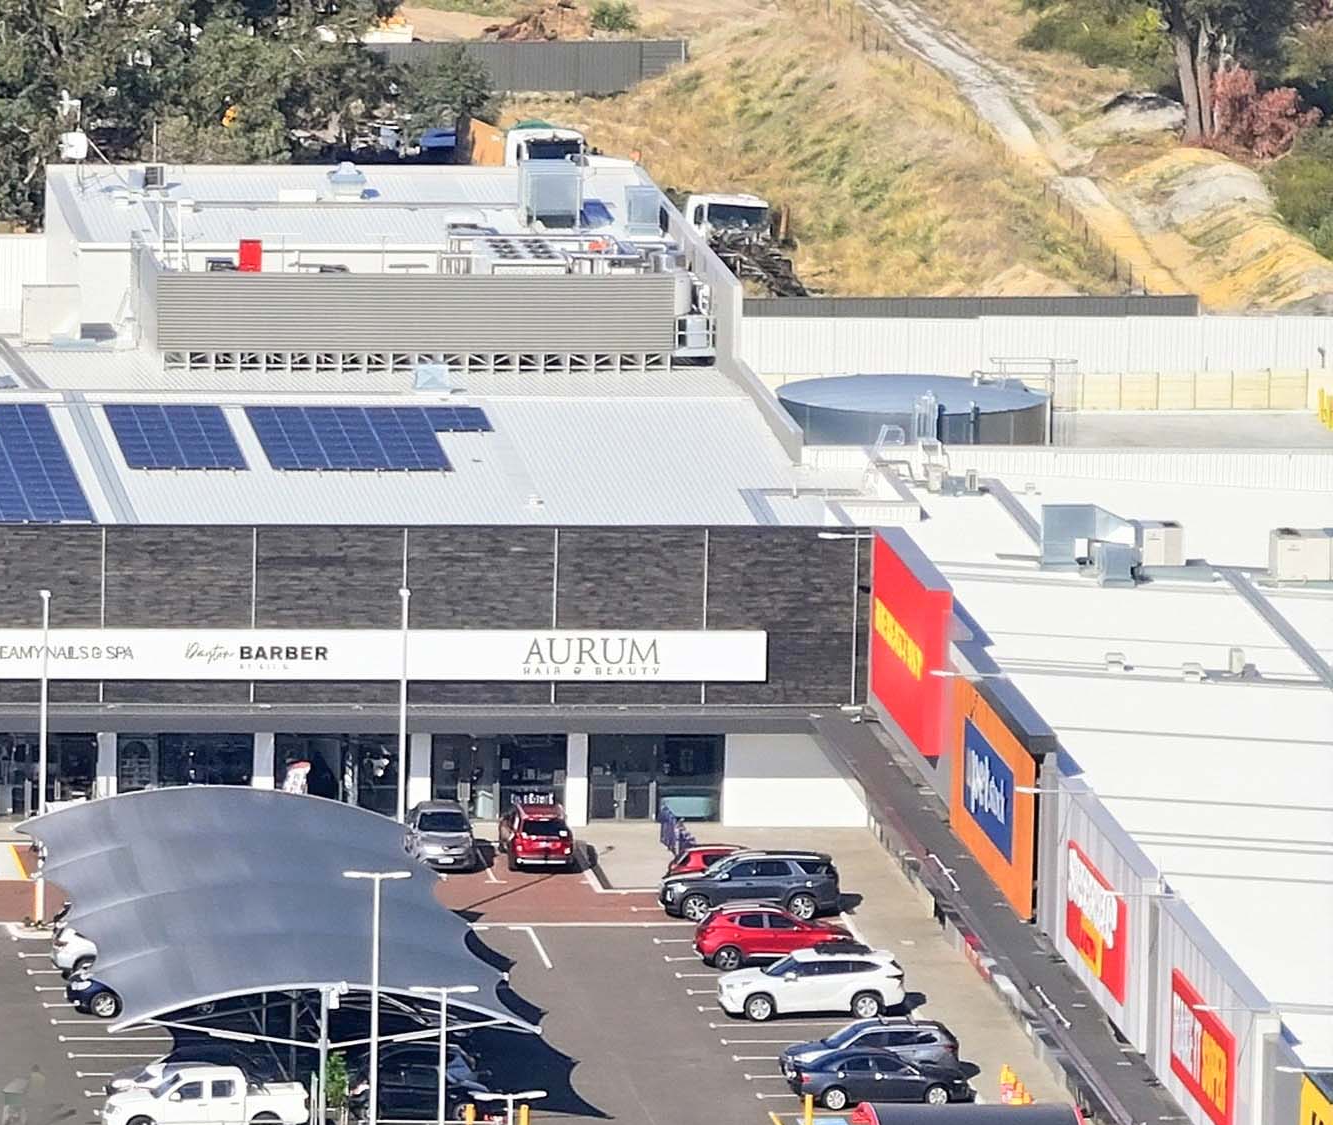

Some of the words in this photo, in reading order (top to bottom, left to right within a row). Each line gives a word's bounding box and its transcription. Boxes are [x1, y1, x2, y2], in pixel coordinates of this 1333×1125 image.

[46, 646, 90, 660] NAILS
[106, 646, 134, 660] SPA
[239, 646, 329, 660] BARBER
[522, 637, 661, 665] AURUM
[523, 667, 561, 675] HAIR
[595, 667, 660, 675] BEAUTY
